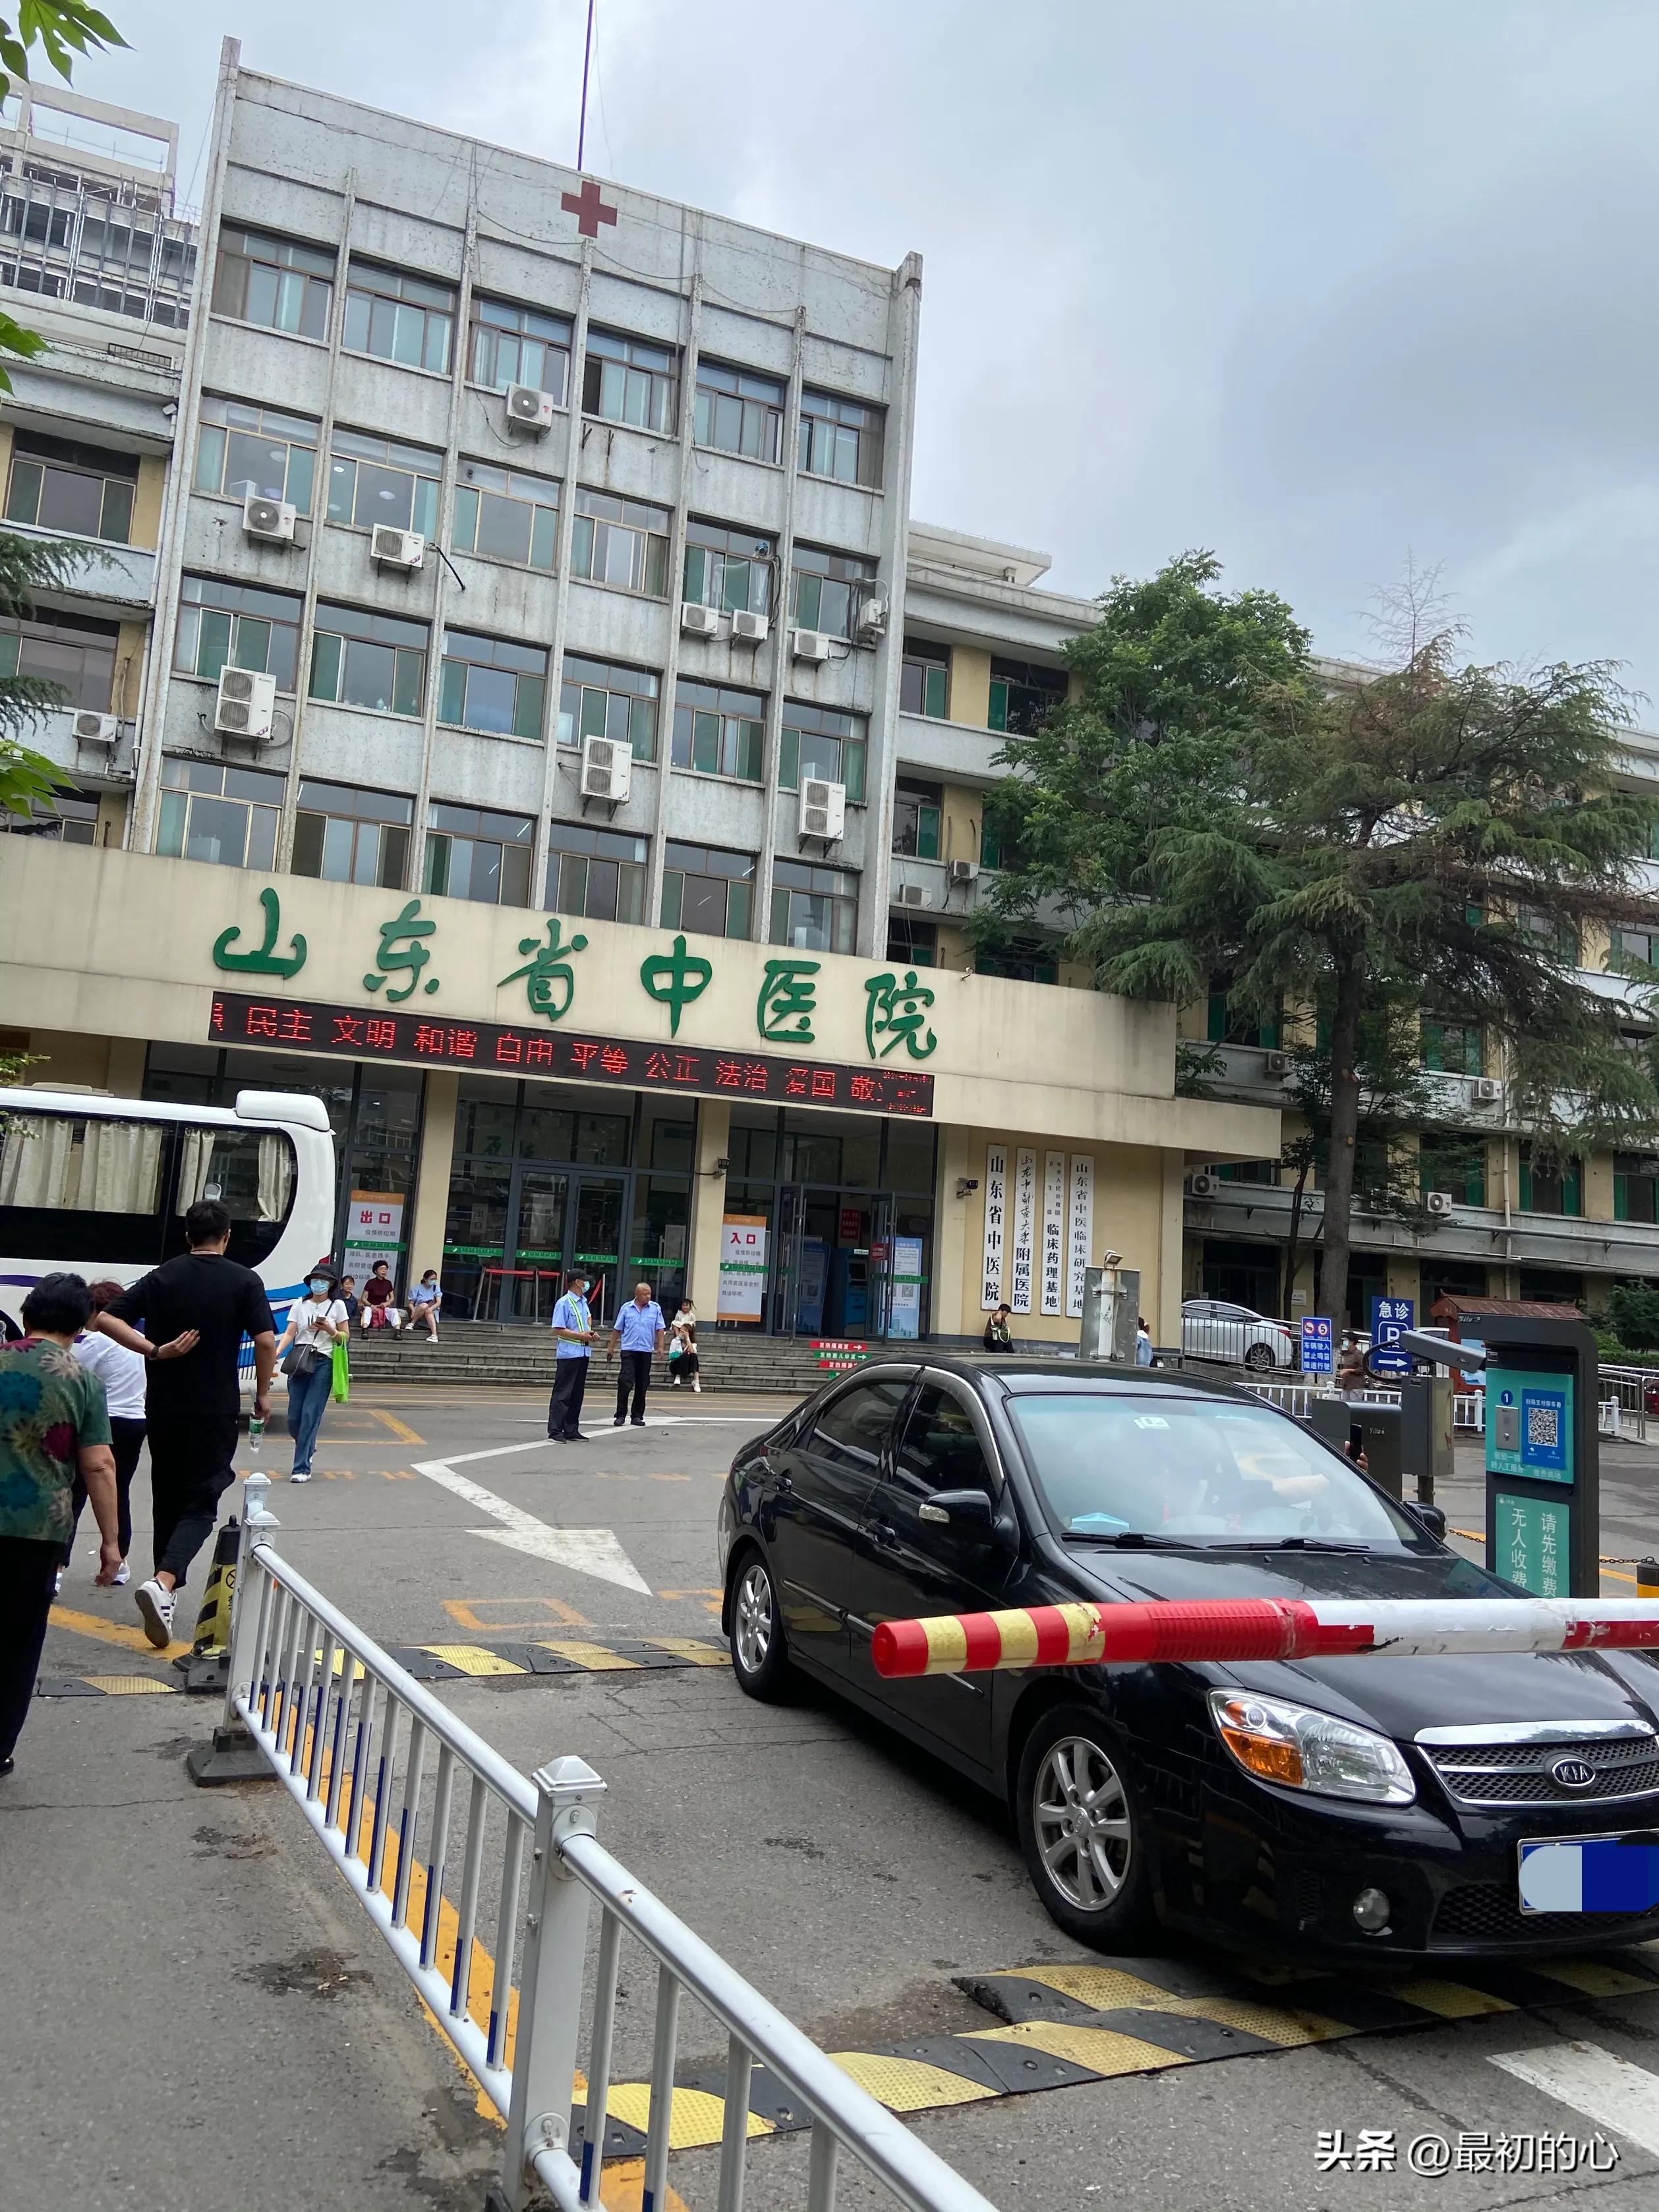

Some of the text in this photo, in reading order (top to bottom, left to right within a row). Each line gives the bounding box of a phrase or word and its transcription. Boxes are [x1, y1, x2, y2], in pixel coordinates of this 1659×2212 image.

[212, 887, 939, 1061] 山东省中医院
[247, 1005, 312, 1041] 民主
[330, 1015, 396, 1049] 文明
[413, 1025, 478, 1059] 和谐
[570, 1043, 629, 1074] 平等
[645, 1052, 701, 1082] 公正
[715, 1059, 769, 1092] 法治
[361, 1210, 391, 1225] 出口
[730, 1232, 756, 1244] 入口
[984, 1155, 1004, 1302] 山东省中医院
[1072, 1163, 1088, 1309] 山东省中医临床研究基地
[1045, 1223, 1060, 1308] 临床药理基地
[1378, 1301, 1410, 1320] 急诊
[1304, 1342, 1329, 1351] 车辆驶入
[1304, 1352, 1330, 1360] 禁止鸣笛
[1304, 1361, 1330, 1370] 限速行驶
[1503, 1393, 1509, 1403] 1
[1511, 1507, 1527, 1588] 无人收费
[1541, 1512, 1557, 1598] 请先缴费
[1559, 1764, 1588, 1781] KIA
